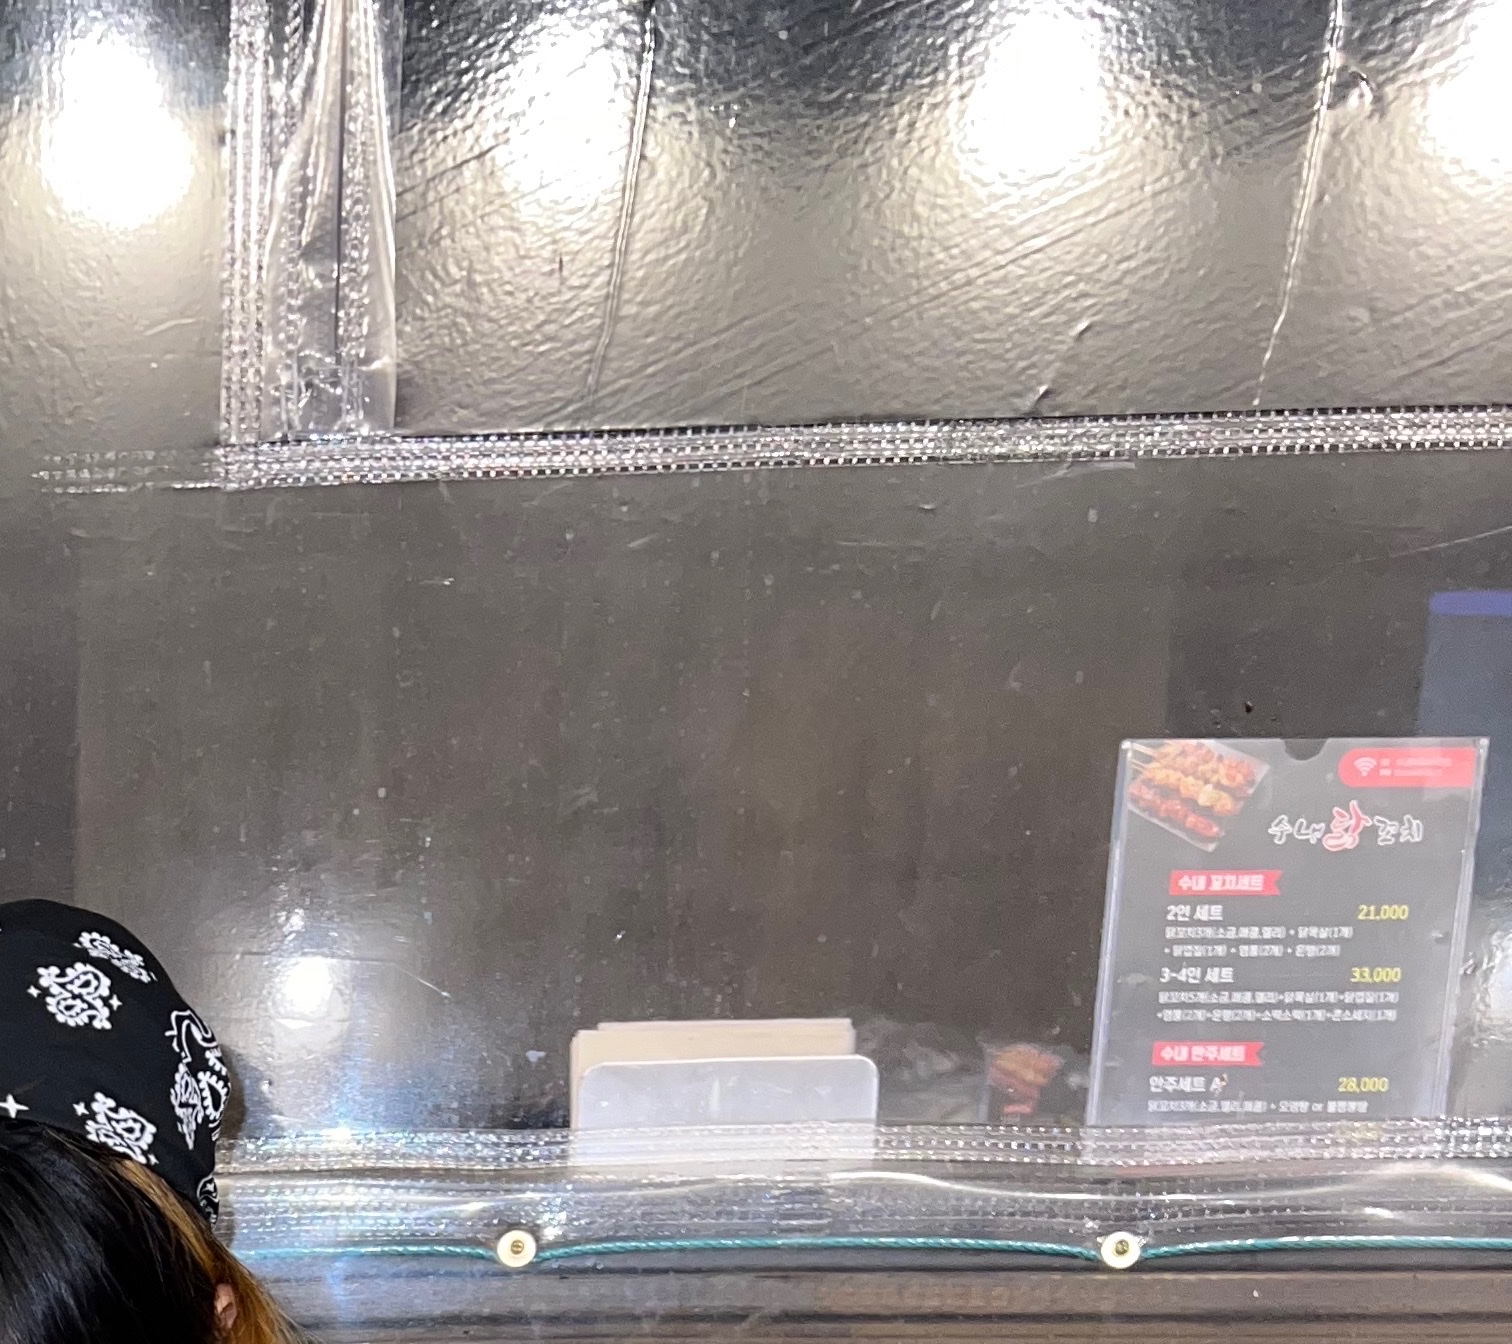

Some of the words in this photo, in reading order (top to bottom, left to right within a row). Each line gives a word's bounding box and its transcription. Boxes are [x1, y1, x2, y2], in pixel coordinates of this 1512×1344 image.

[1166, 905, 1190, 921] 2인
[1193, 905, 1224, 921] 세트
[1357, 905, 1409, 921] 21,000
[1204, 967, 1234, 983] 세트
[1350, 967, 1401, 983] 33,000
[1149, 1075, 1207, 1092] 안주세트
[1338, 1077, 1390, 1093] 28,000
